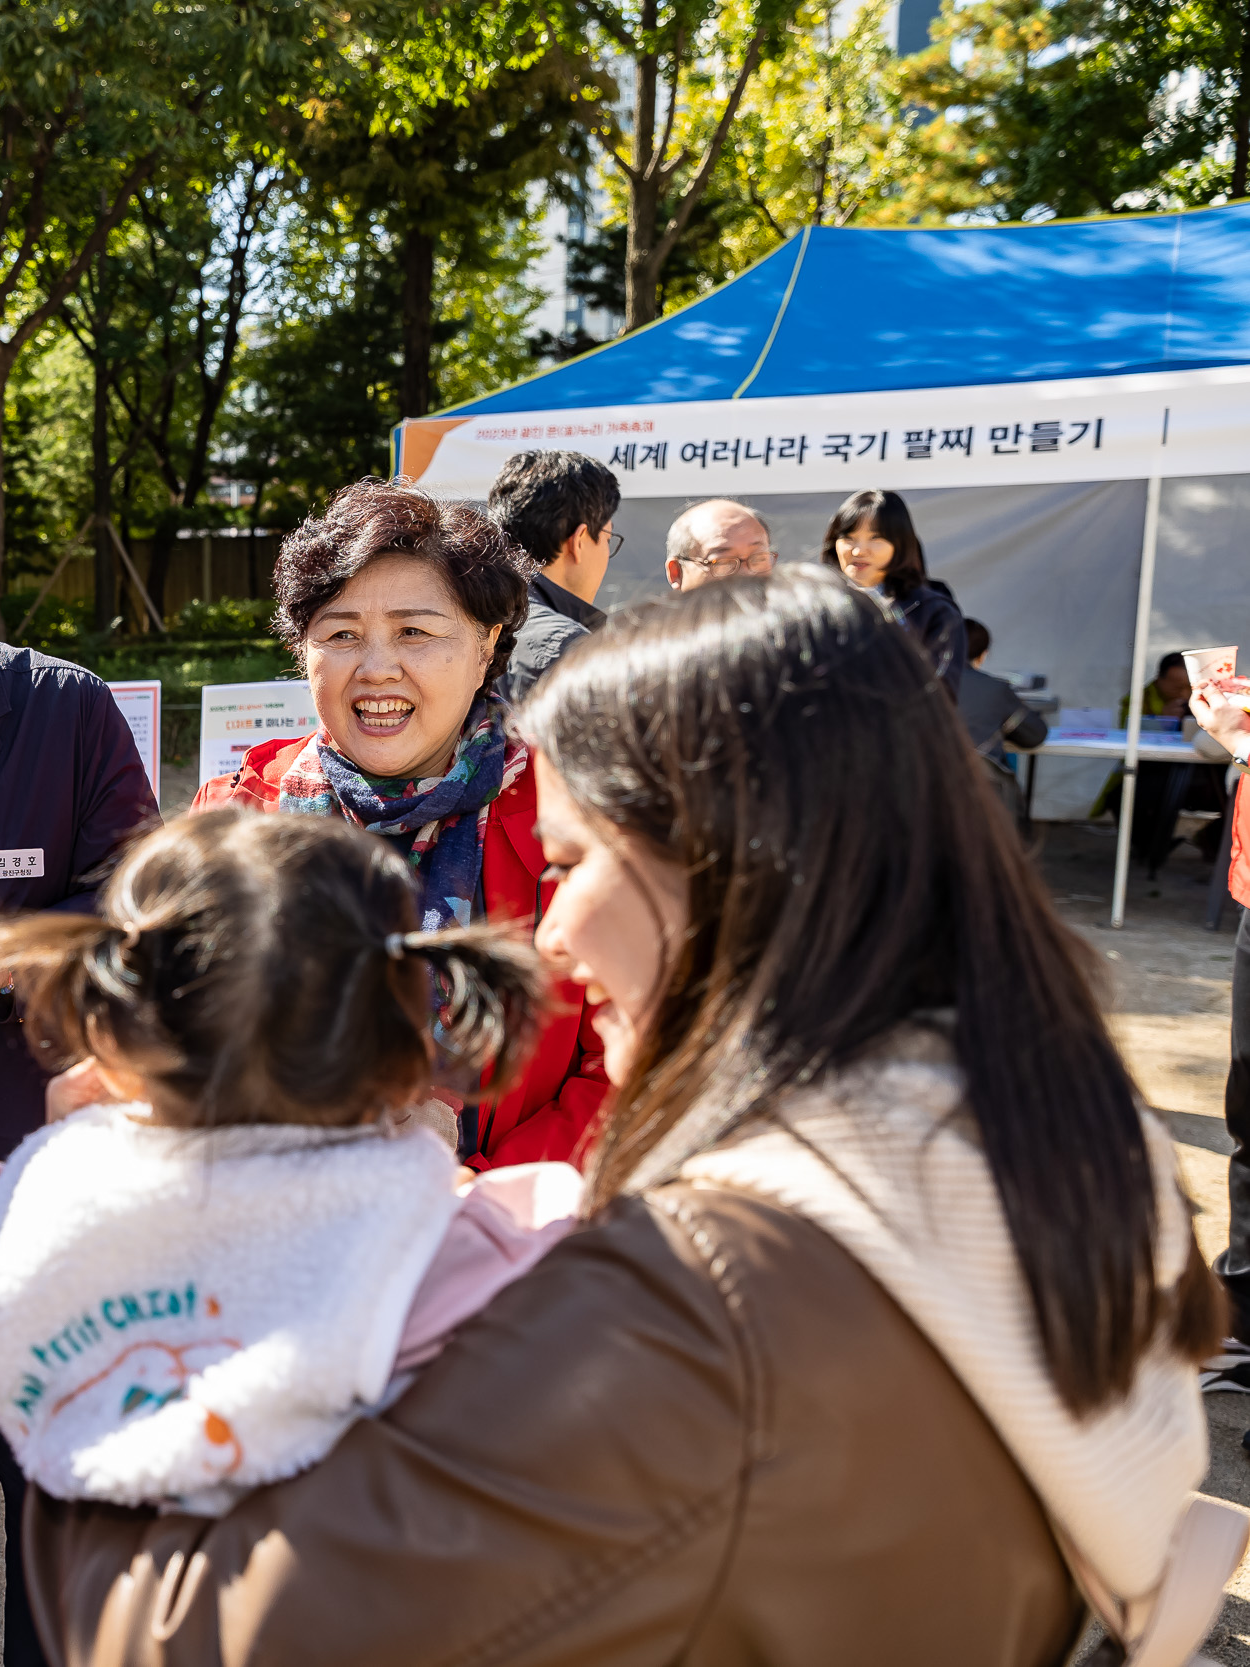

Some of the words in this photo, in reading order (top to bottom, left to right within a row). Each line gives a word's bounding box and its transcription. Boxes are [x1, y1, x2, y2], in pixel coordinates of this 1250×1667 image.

[609, 442, 669, 470] 세계
[680, 434, 808, 468] 여러나라
[822, 431, 889, 462] 국기
[903, 426, 975, 458] 팔찌
[989, 417, 1104, 455] 만들기
